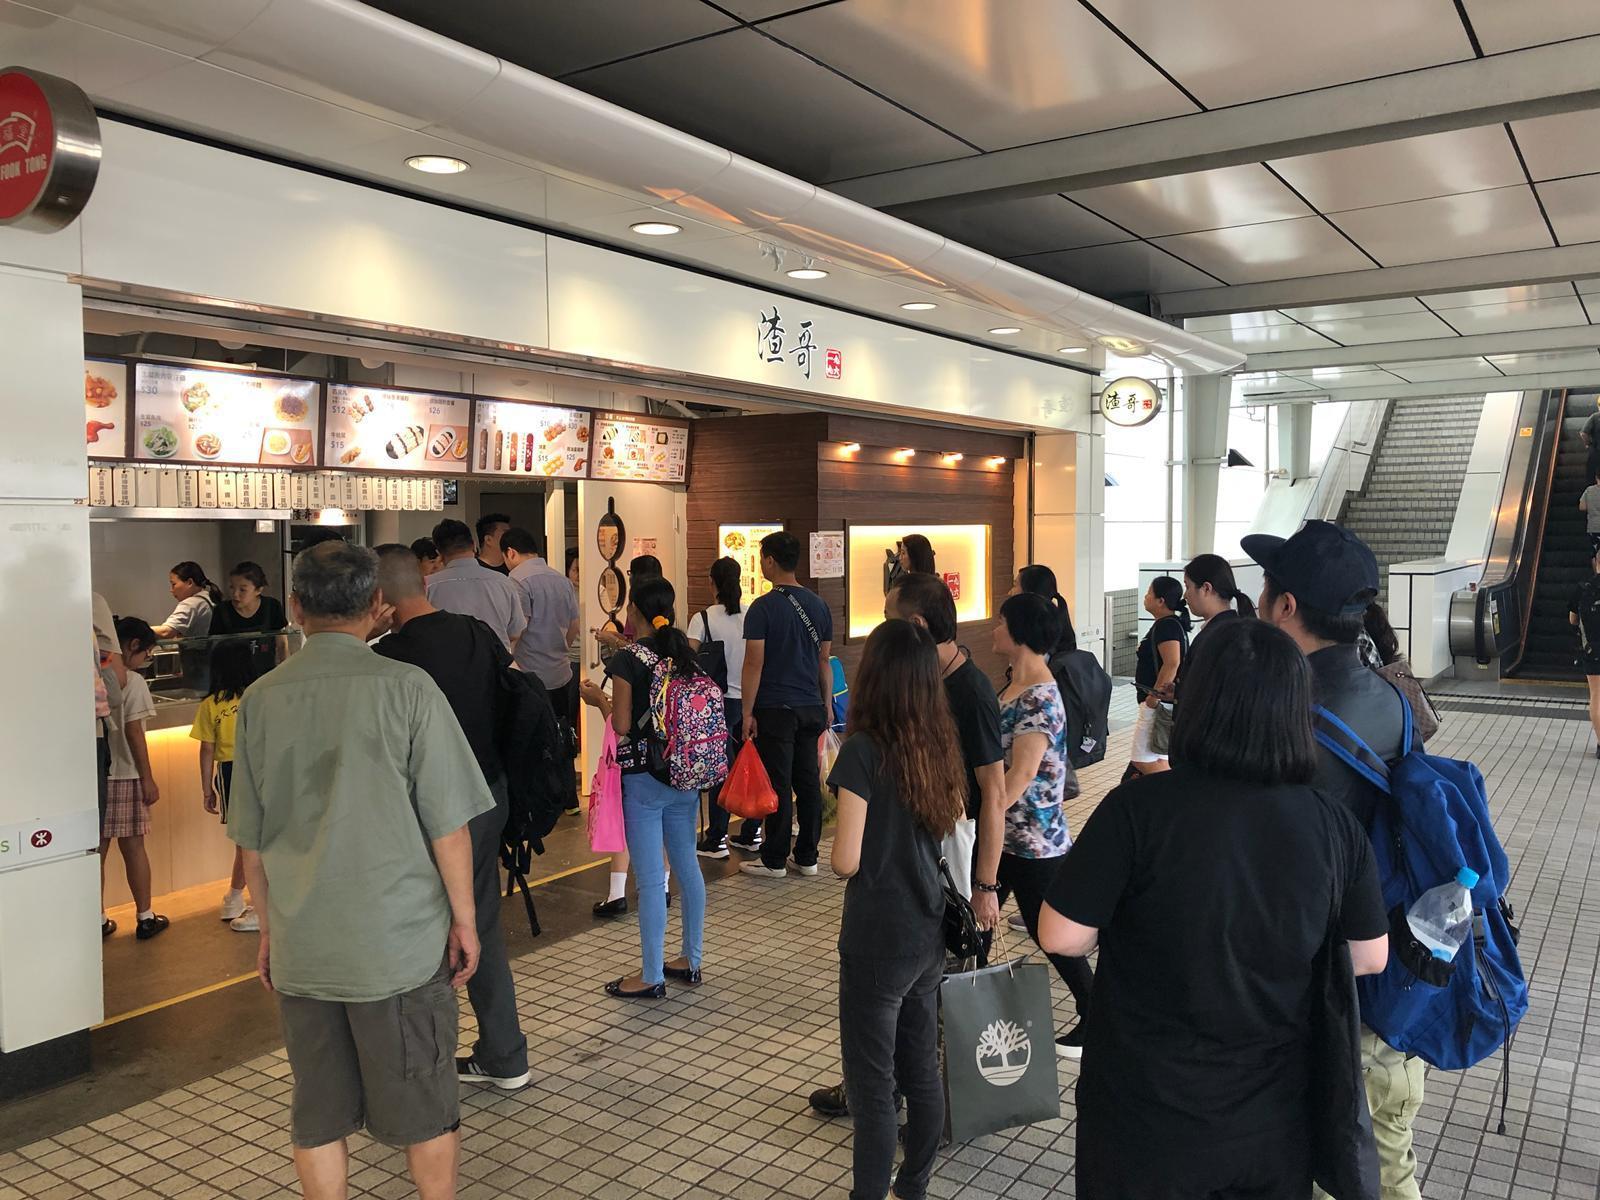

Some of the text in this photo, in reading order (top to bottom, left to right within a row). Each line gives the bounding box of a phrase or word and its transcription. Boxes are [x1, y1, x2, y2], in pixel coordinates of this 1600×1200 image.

[0, 153, 47, 181] FOOK TONG
[758, 306, 817, 379] 渣哥
[332, 405, 346, 414] $12
[1105, 391, 1139, 413] 渣哥
[330, 440, 345, 449] $15
[538, 454, 548, 462] $15
